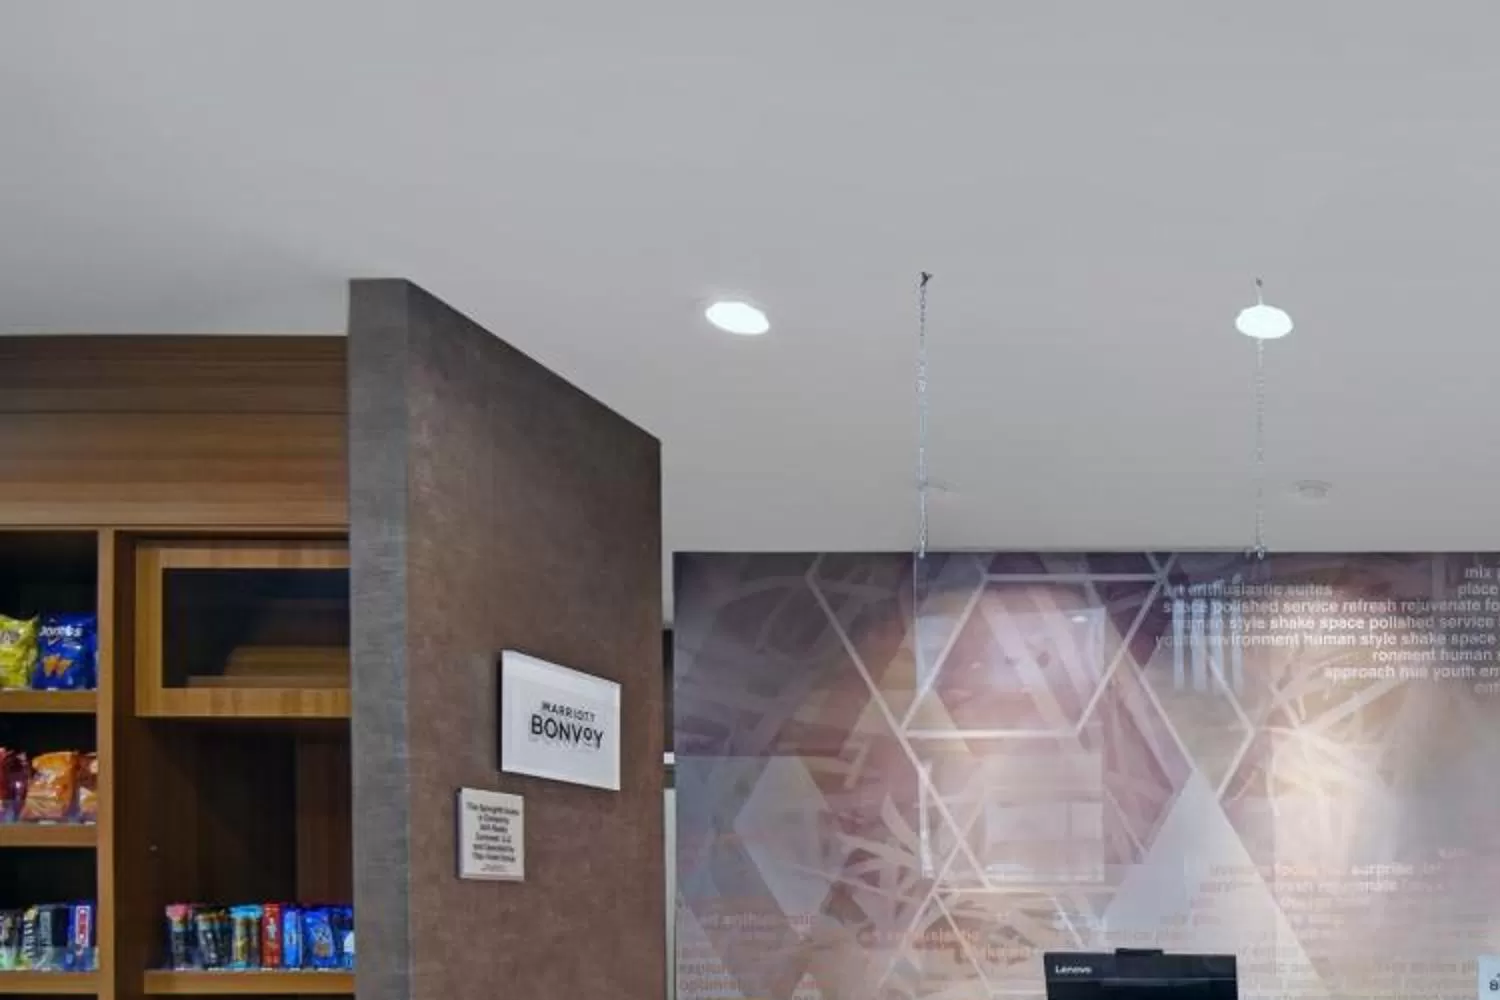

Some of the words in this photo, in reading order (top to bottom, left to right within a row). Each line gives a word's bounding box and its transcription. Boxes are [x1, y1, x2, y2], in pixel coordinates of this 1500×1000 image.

[1465, 566, 1491, 579] mix
[1458, 582, 1498, 599] place
[1282, 600, 1338, 612] service
[1342, 600, 1396, 612] refresh
[1400, 600, 1481, 616] rejuvenate
[1271, 617, 1314, 629] shake
[1319, 619, 1364, 633] space
[1369, 616, 1433, 633] polished
[1439, 617, 1494, 629] service
[1304, 632, 1356, 645] human
[1360, 632, 1396, 649] style
[1402, 632, 1446, 645] shake
[1451, 635, 1497, 649] space
[1440, 648, 1493, 661] human
[1433, 665, 1475, 682] youth
[531, 713, 604, 749] BONVOY
[1055, 964, 1092, 974] Lenovo
